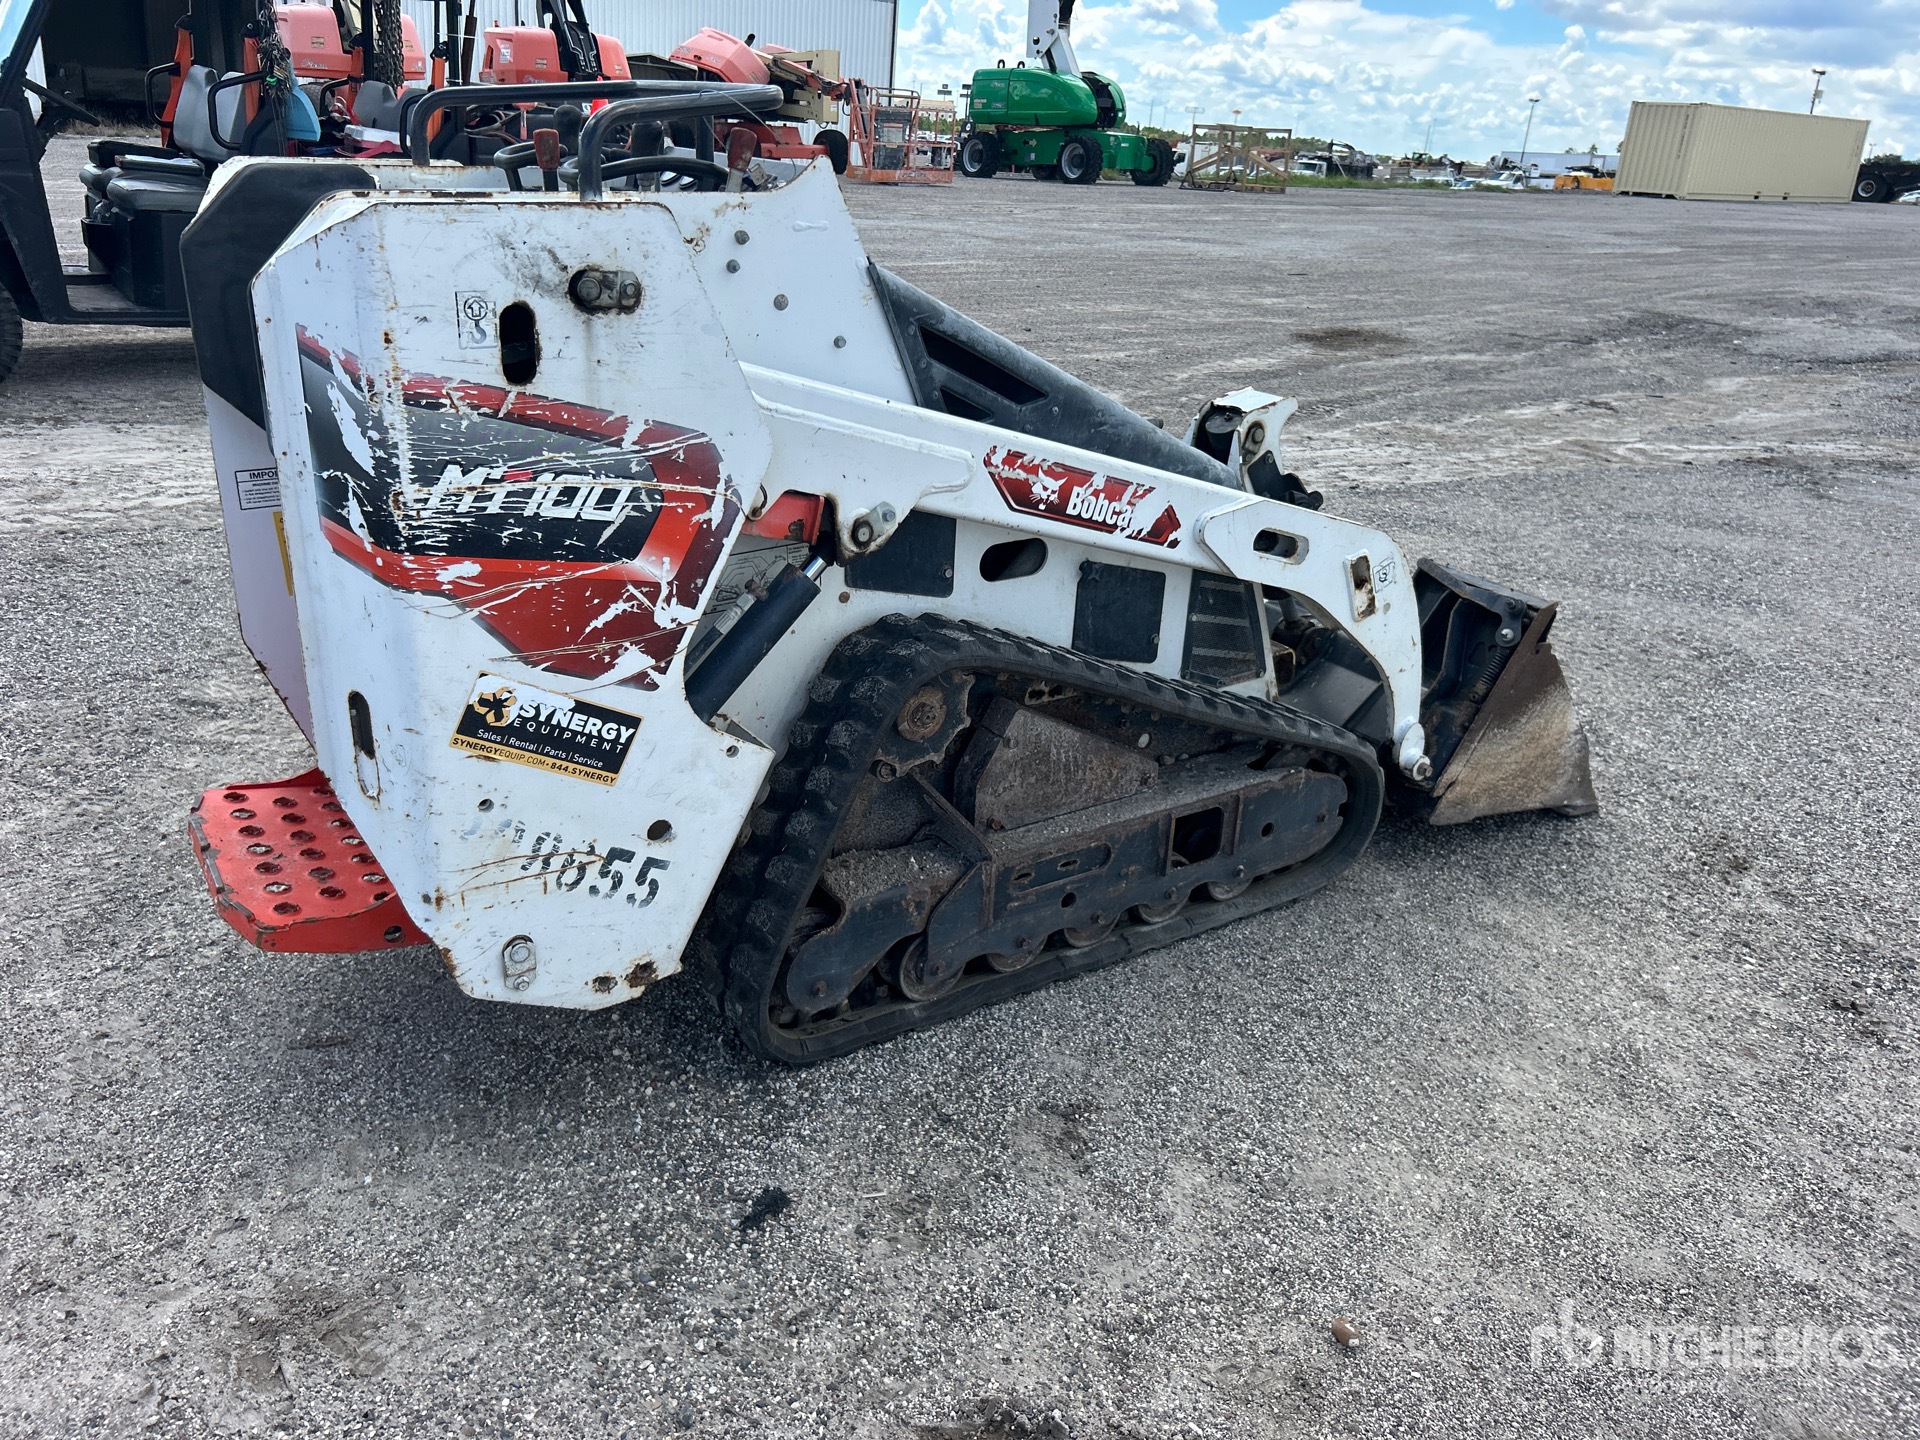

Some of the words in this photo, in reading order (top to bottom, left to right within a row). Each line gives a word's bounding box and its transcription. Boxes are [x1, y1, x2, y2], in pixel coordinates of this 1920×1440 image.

[513, 717, 627, 754] EQUIPMENT
[519, 700, 636, 744] SYNERGY
[452, 737, 546, 767] SYNERGYEQUIP.COM
[550, 761, 617, 784] 844.SYNERGY
[477, 729, 502, 742] Sales
[509, 737, 537, 752] Rental
[544, 746, 567, 759] Parts
[573, 753, 604, 768] Service
